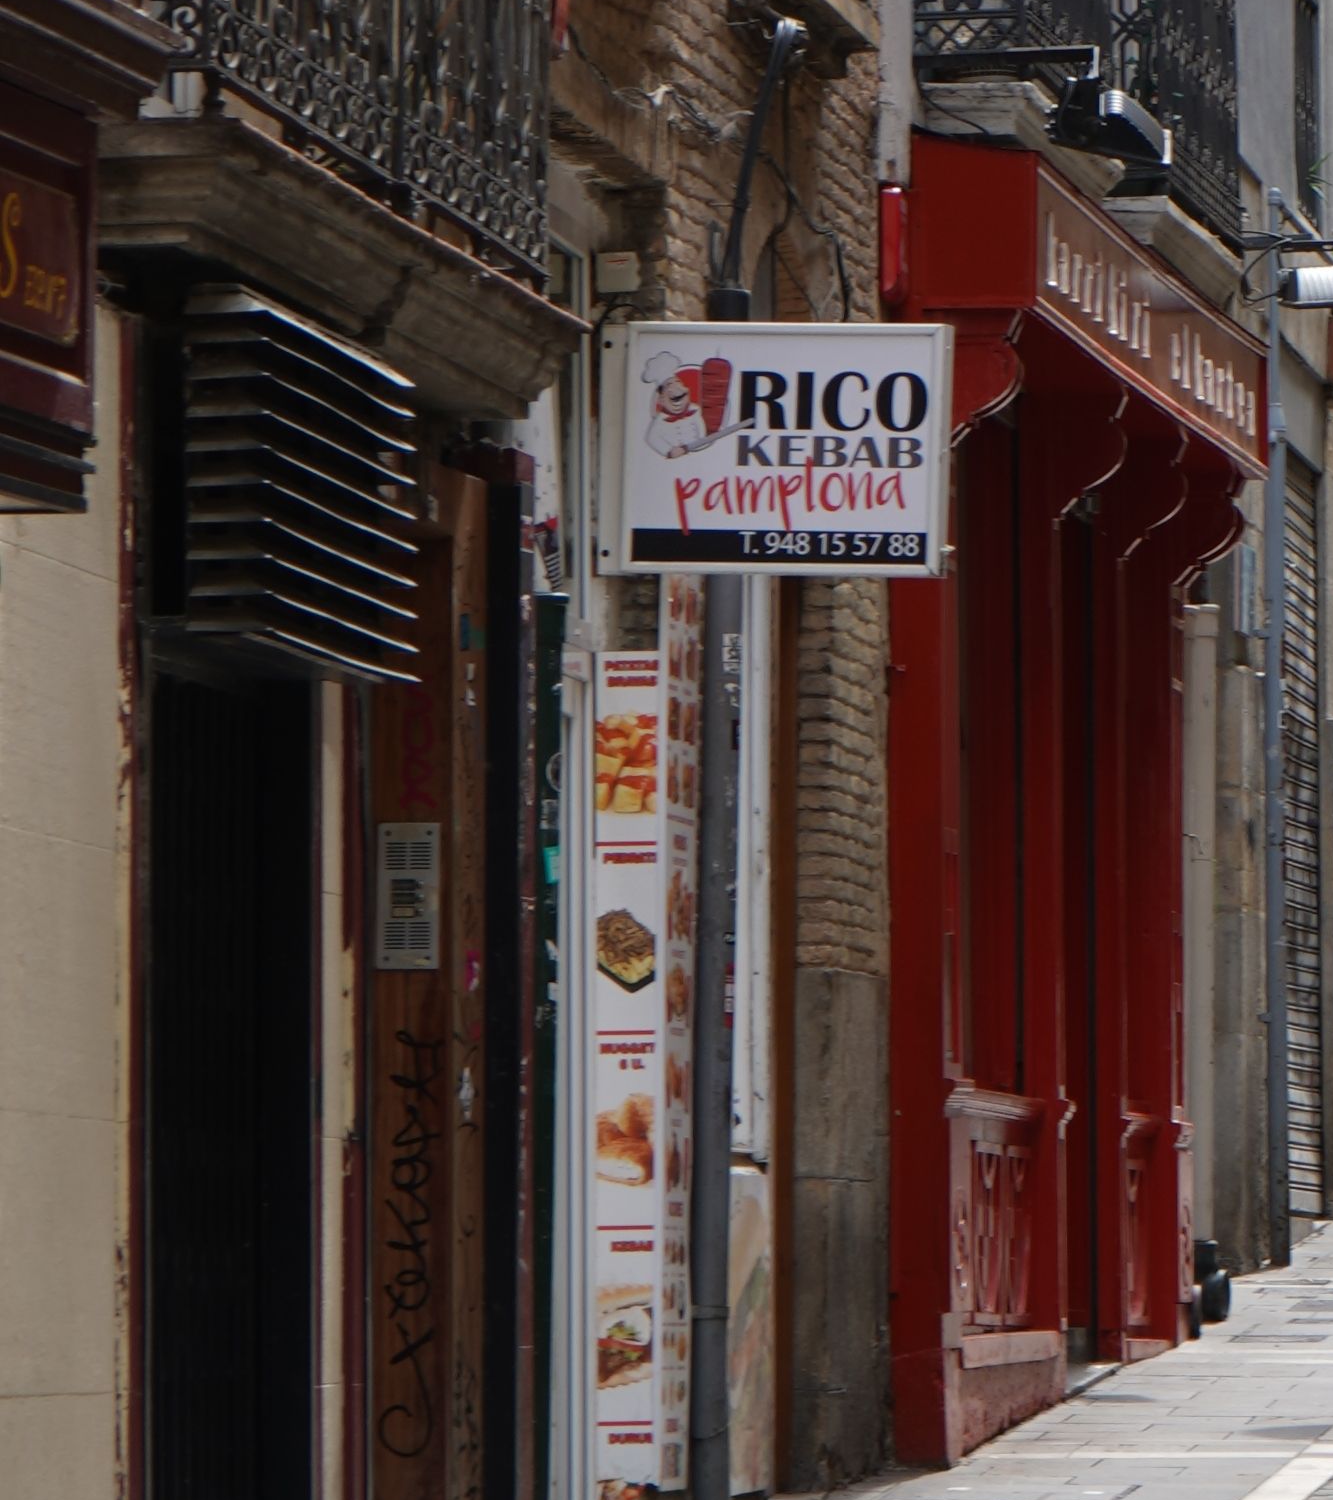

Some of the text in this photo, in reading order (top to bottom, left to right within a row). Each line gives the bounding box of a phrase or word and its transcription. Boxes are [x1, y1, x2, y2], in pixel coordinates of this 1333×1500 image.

[738, 370, 928, 432] RICO
[736, 435, 923, 469] KEBAB
[673, 456, 906, 536] pamplona
[740, 531, 920, 557] T. 948 15 57 88
